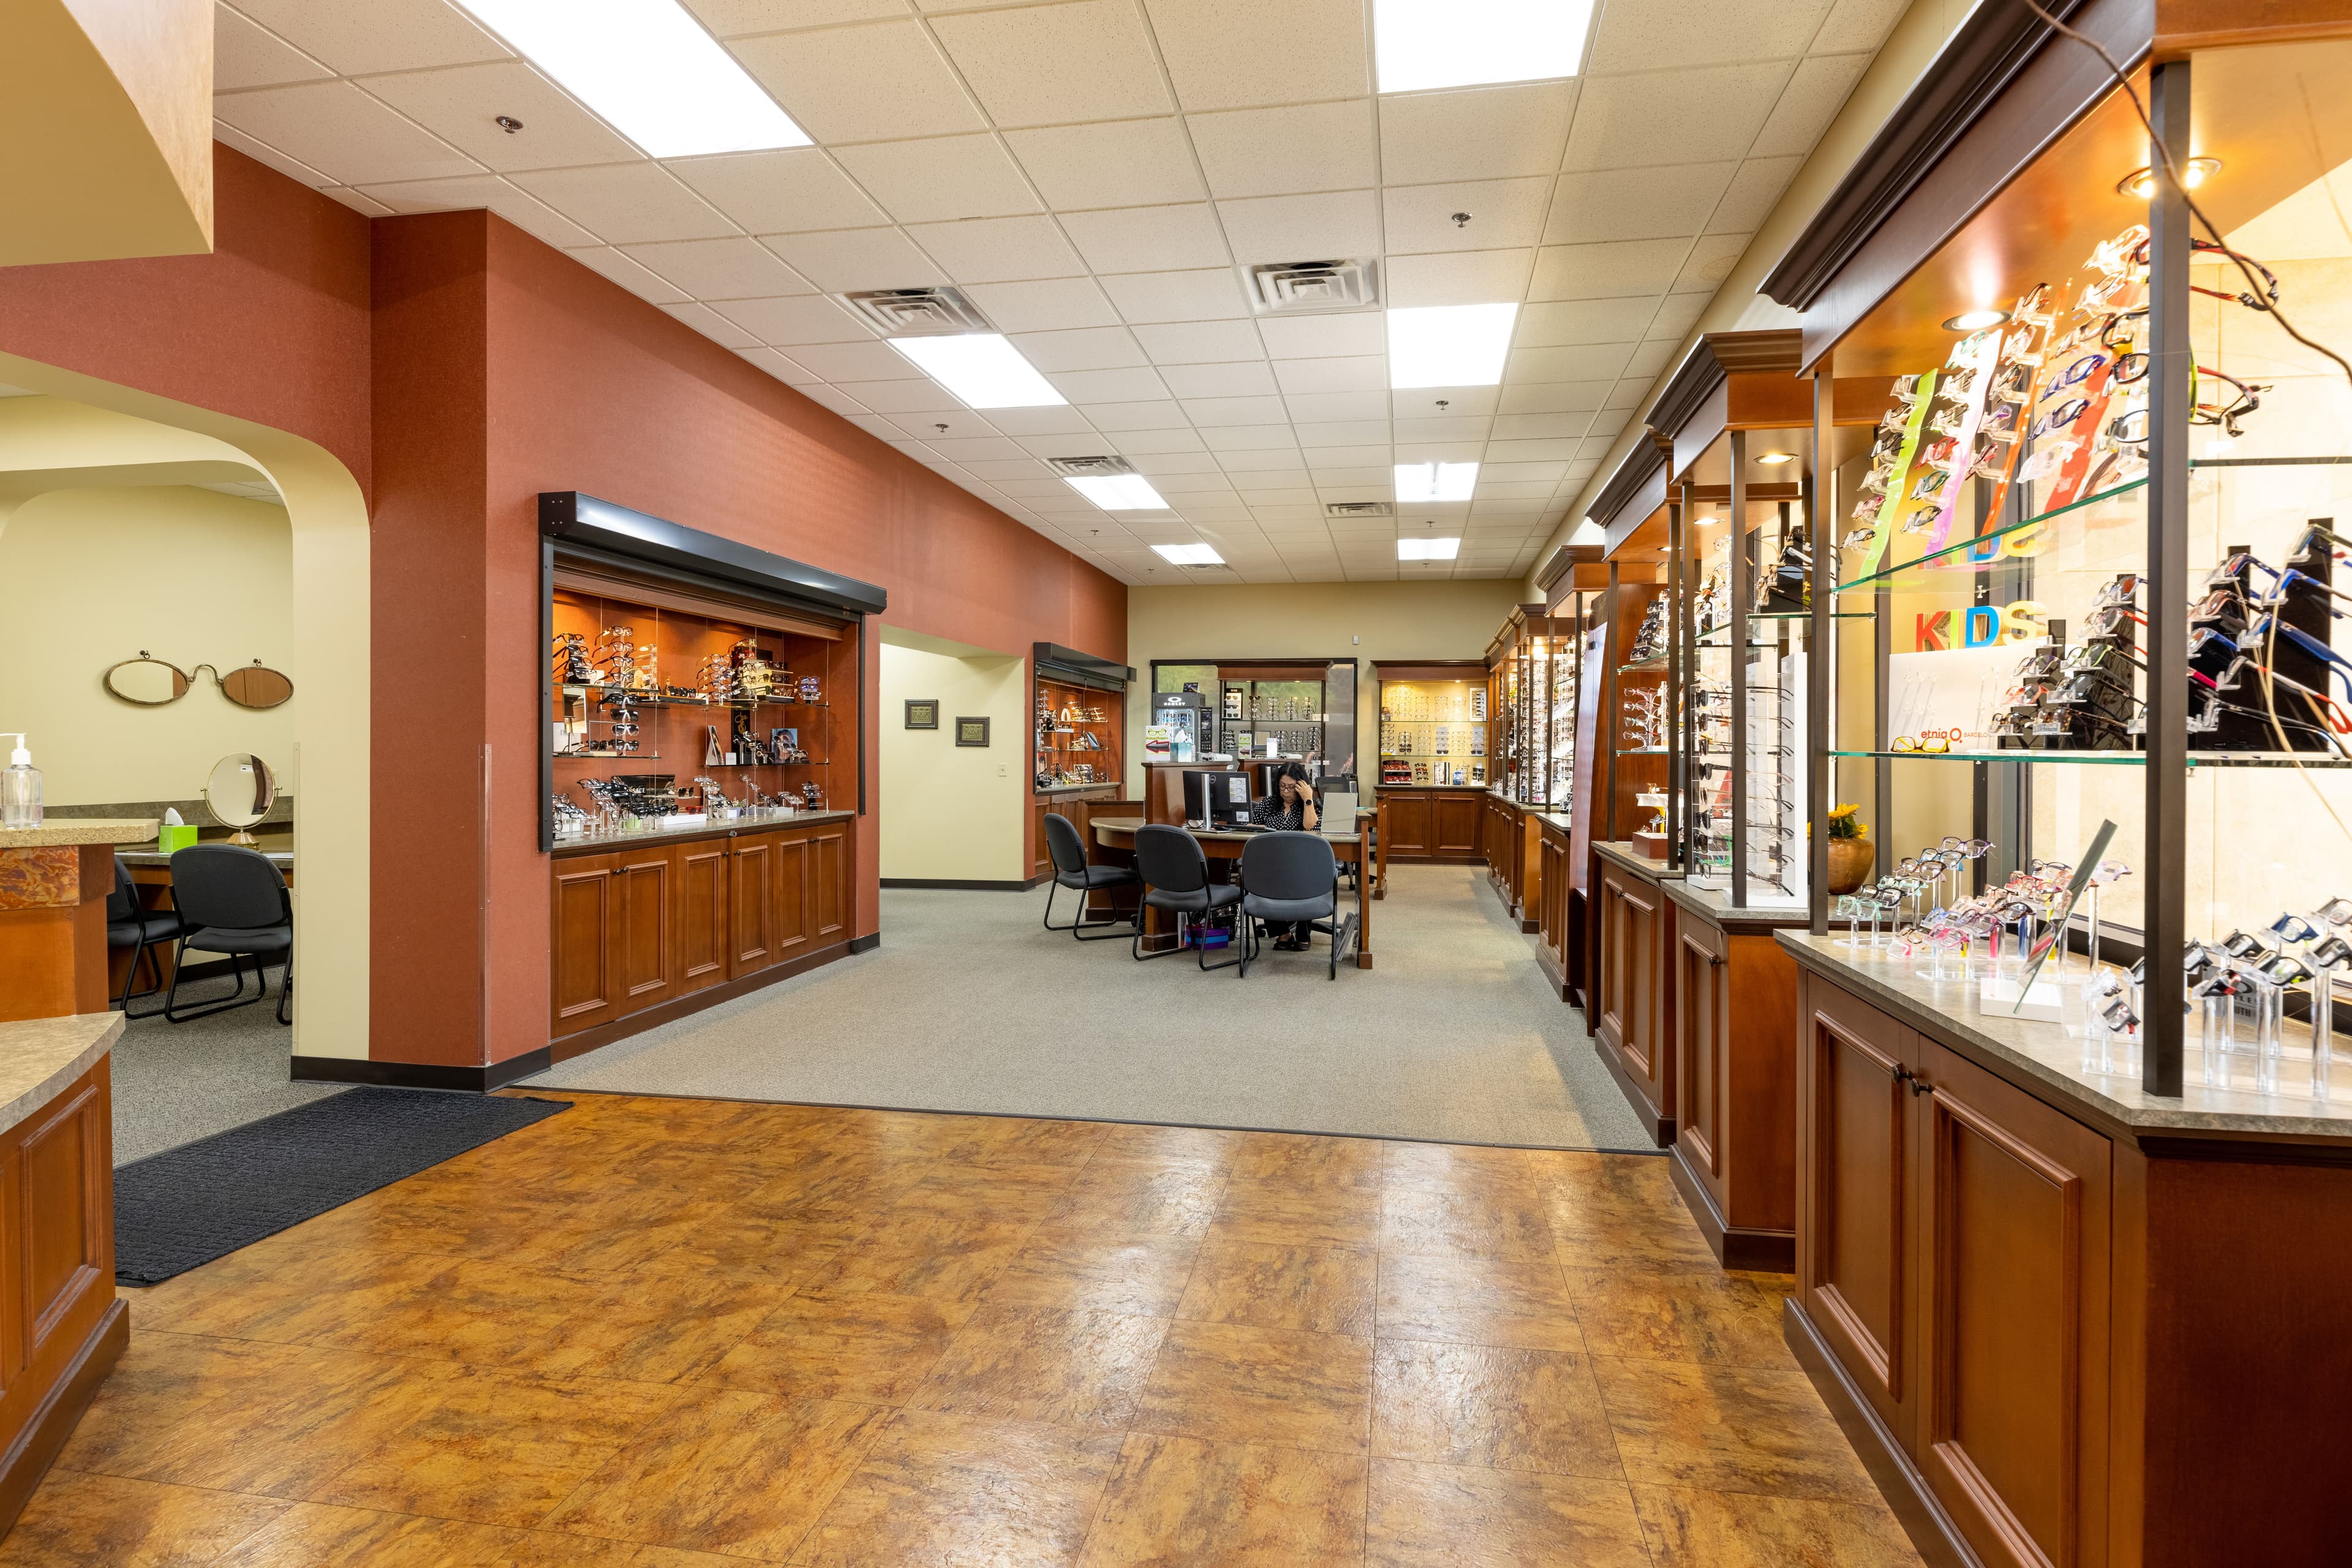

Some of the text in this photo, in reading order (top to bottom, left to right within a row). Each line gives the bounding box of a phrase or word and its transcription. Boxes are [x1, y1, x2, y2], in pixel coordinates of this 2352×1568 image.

[1916, 601, 2048, 652] KIDS
[1921, 728, 1947, 739] etnia
[2234, 1005, 2251, 1017] UTH
